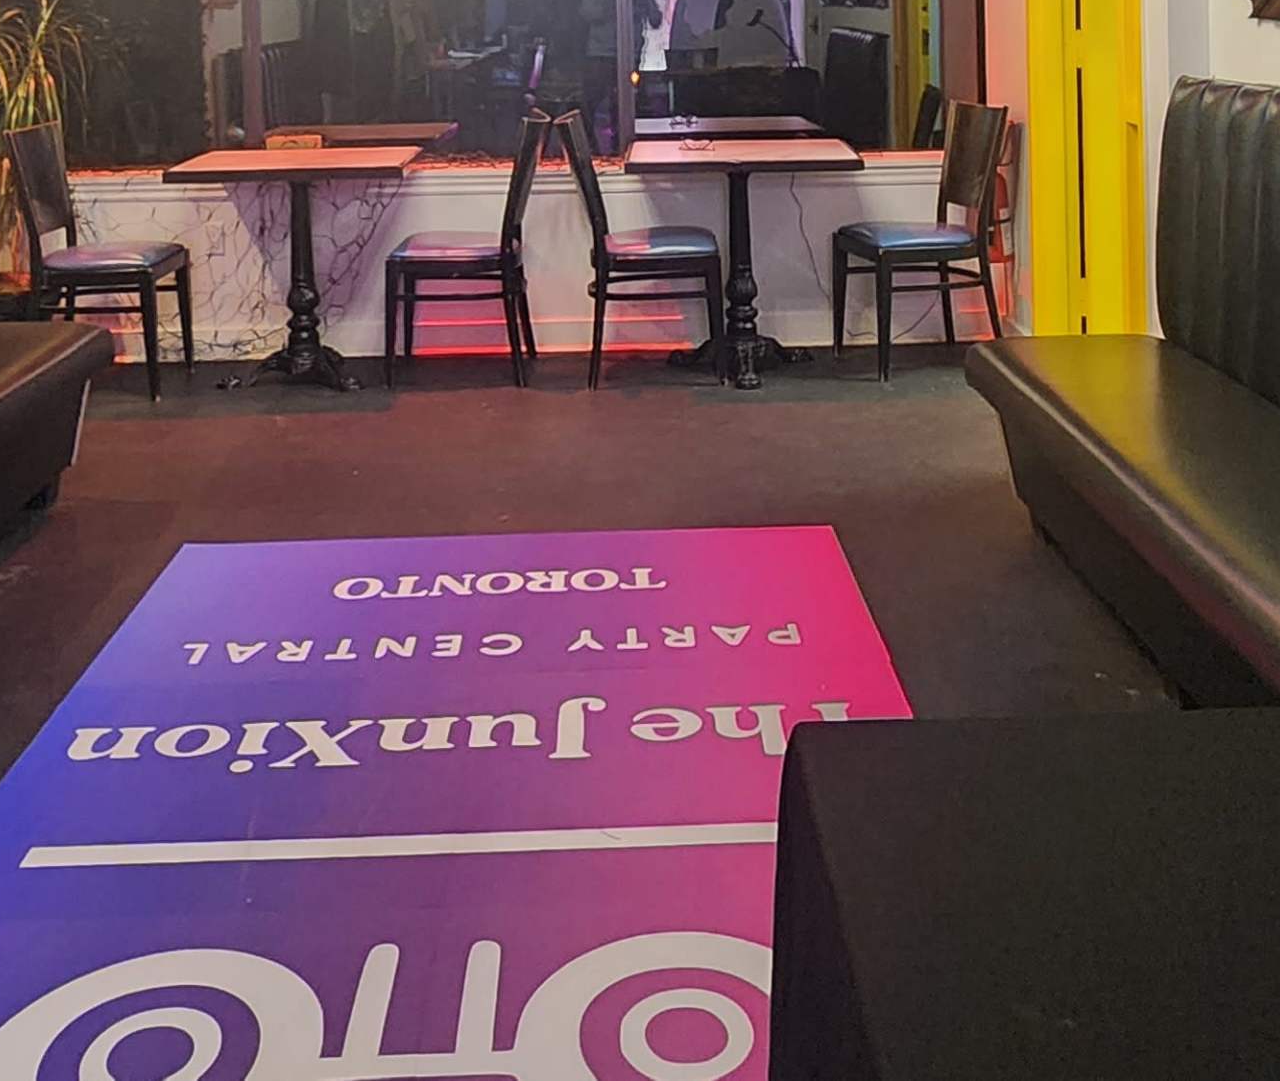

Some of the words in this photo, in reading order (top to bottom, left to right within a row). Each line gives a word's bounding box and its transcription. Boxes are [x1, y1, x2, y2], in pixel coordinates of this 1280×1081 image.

[332, 567, 667, 600] TORONTO
[183, 633, 523, 665] CENTRAL
[567, 623, 802, 652] PARTY
[66, 697, 607, 773] JunXion
[630, 702, 850, 756] he
